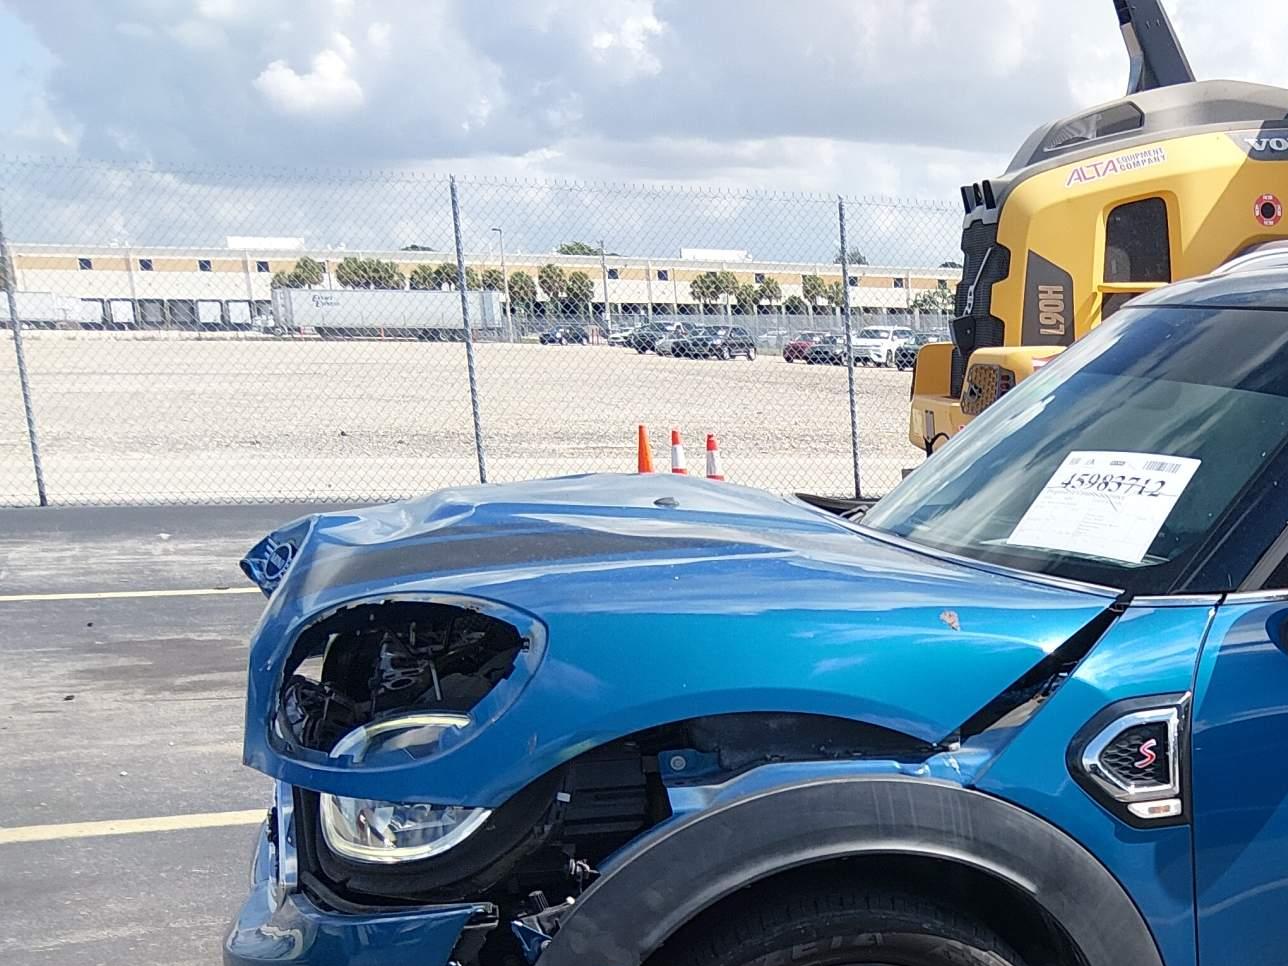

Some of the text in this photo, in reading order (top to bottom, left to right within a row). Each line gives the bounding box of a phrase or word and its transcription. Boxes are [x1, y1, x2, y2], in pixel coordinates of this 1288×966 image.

[1116, 147, 1164, 164] EQUIPMENT
[1119, 154, 1166, 172] COMPANY
[1066, 159, 1118, 186] ALTA
[1038, 285, 1065, 335] L90H
[1061, 473, 1166, 497] 45983712
[1134, 738, 1156, 768] S
